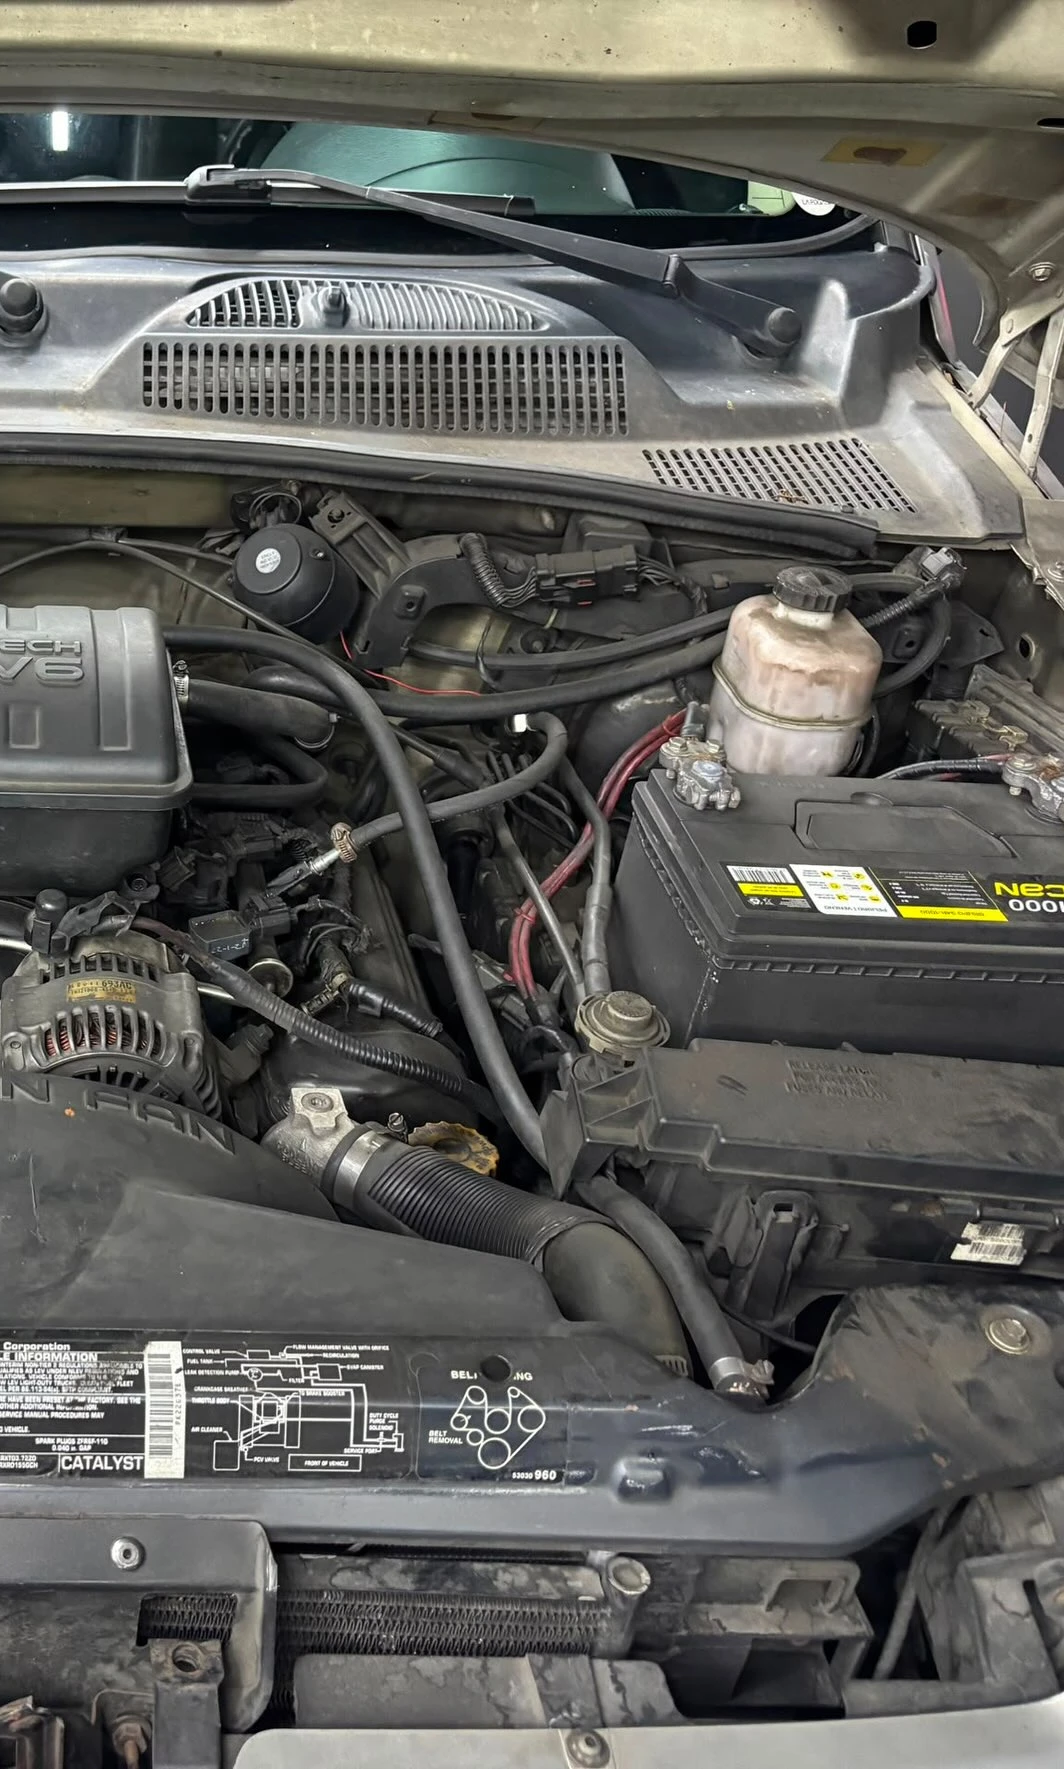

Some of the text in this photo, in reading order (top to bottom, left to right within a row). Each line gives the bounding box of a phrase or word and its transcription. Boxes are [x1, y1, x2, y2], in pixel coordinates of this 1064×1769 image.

[83, 1087, 236, 1156] FAN
[3, 1342, 71, 1353] Corporation
[15, 1352, 98, 1362] INFORMATION
[61, 1456, 144, 1470] CATALYST
[534, 1470, 556, 1480] 960
